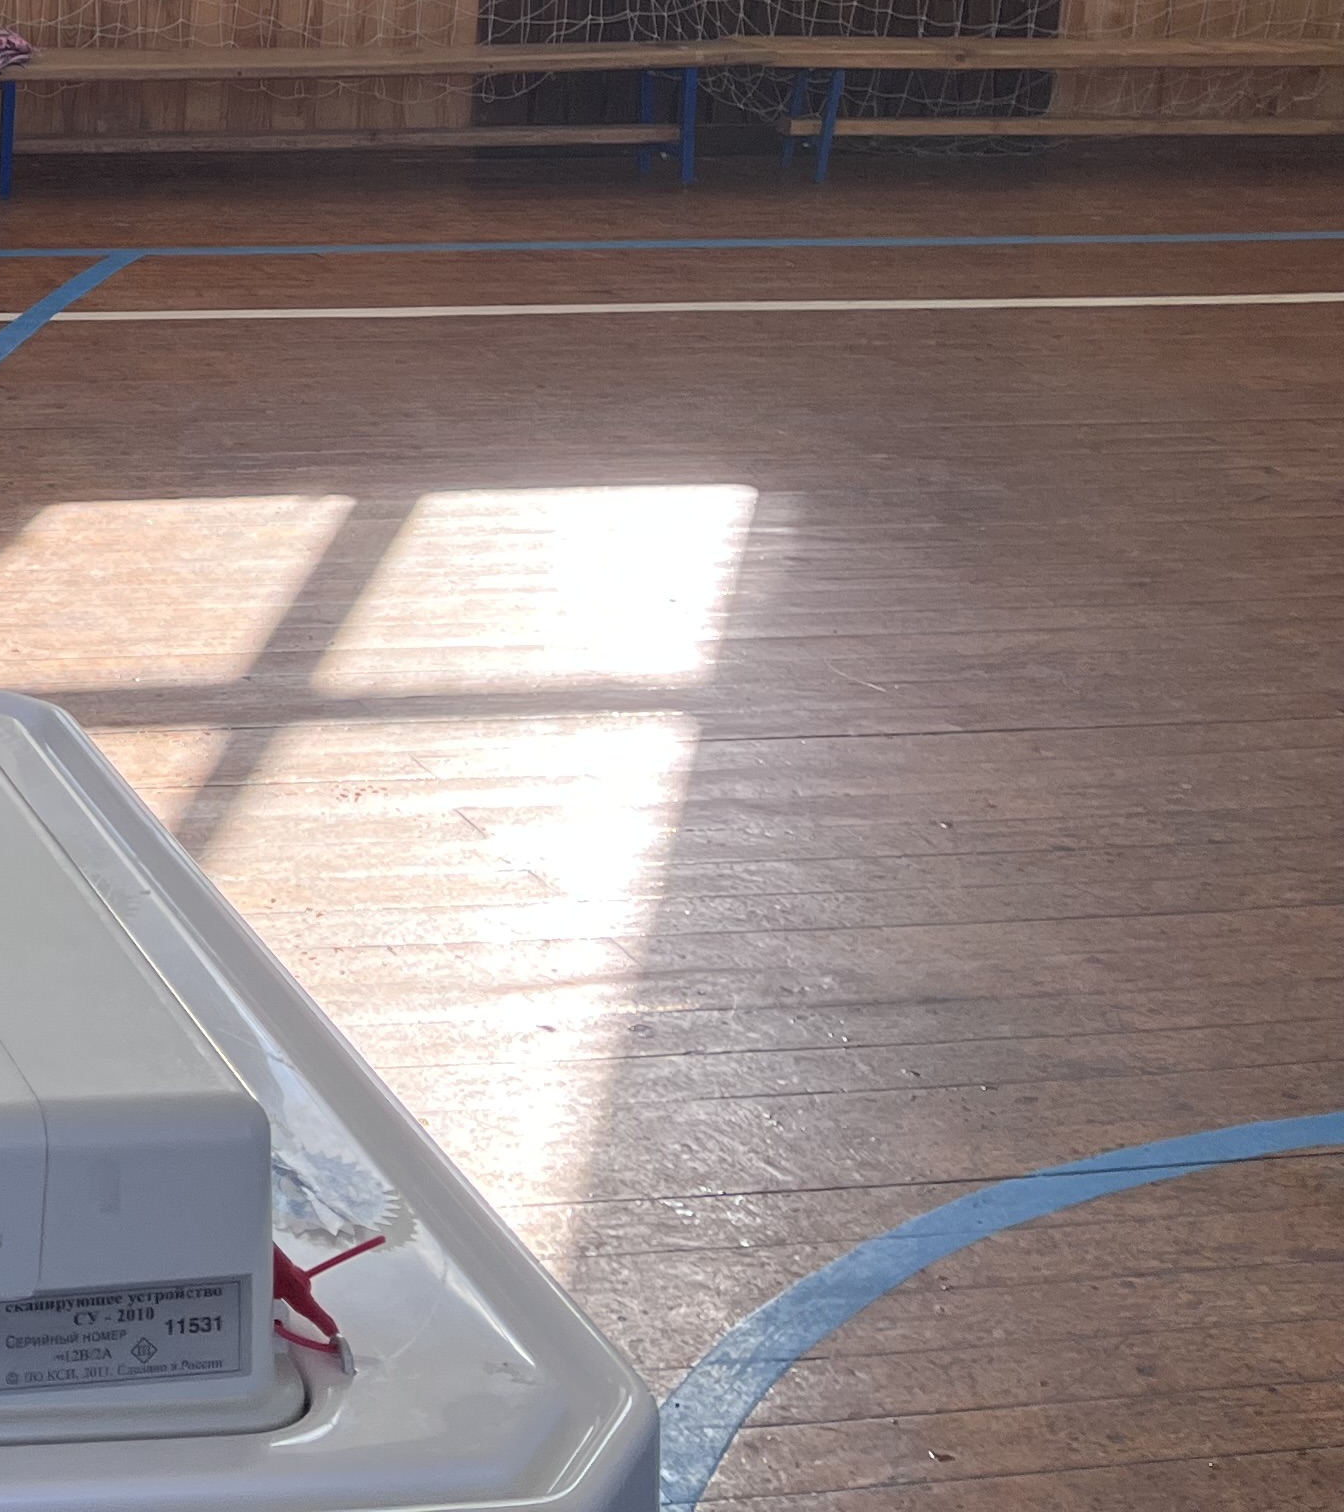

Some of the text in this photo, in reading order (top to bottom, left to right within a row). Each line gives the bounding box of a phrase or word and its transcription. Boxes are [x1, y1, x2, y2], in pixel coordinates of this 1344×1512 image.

[73, 1310, 100, 1327] СУ
[116, 1306, 155, 1323] 2010
[164, 1315, 224, 1336] 11531
